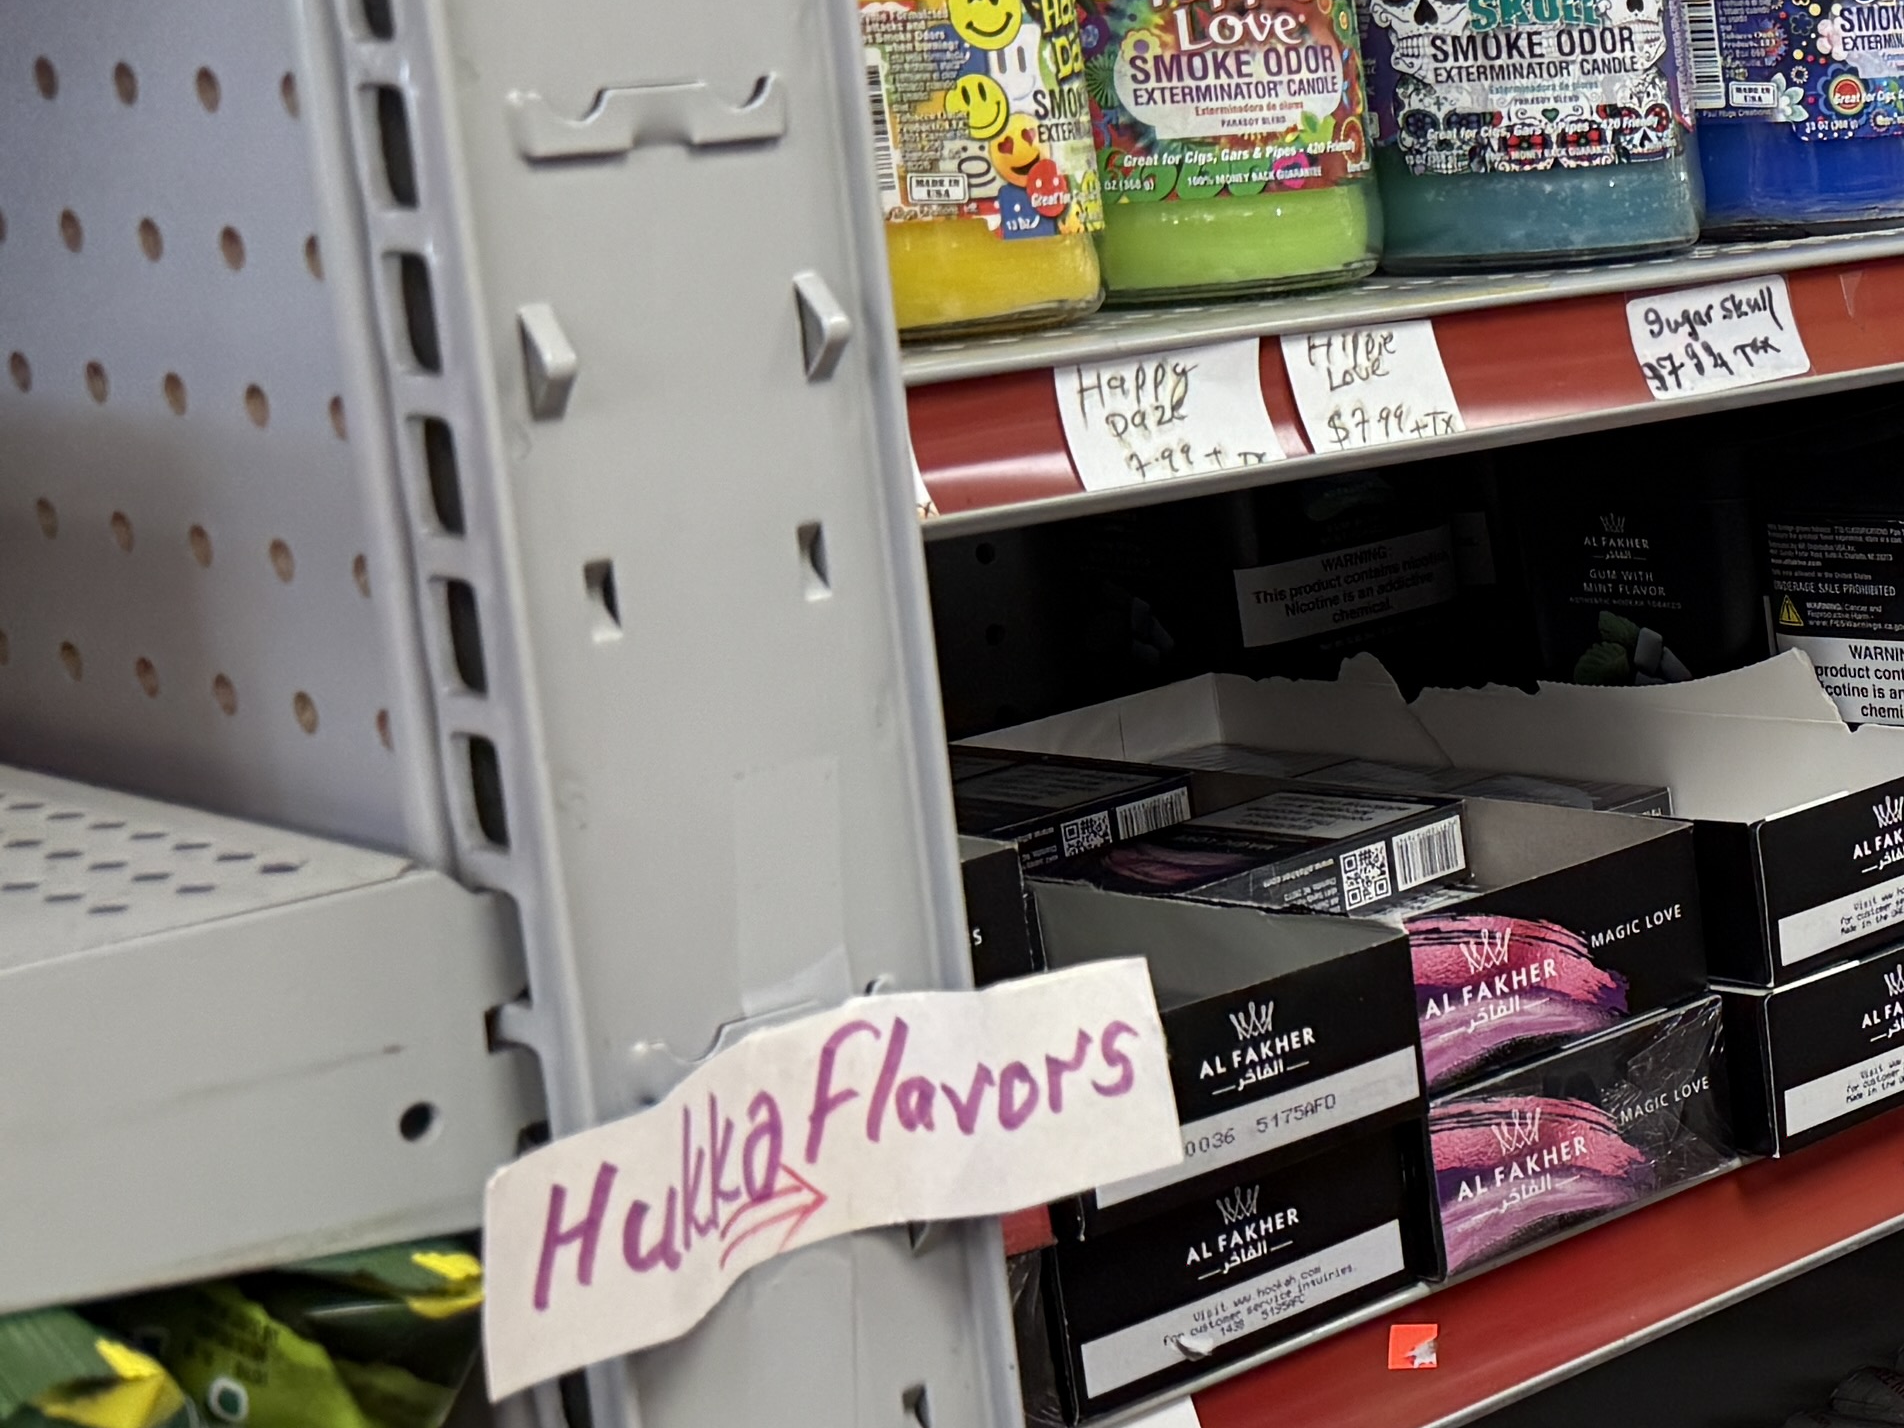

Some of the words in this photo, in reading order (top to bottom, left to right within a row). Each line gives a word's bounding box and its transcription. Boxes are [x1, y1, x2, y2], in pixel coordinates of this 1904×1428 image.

[1172, 8, 1301, 50] Love
[1430, 34, 1546, 64] SMOKE
[1557, 27, 1636, 56] ODOR
[1129, 53, 1236, 87] SMOKE
[1244, 45, 1335, 78] ODOR
[1433, 63, 1575, 85] EXTERMINATOR
[1579, 56, 1639, 76] CANDLE
[1133, 81, 1282, 107] EXTERMINATOR
[1285, 74, 1338, 97] CANDLE
[1124, 152, 1162, 168] Great
[1163, 150, 1183, 167] for
[1184, 149, 1217, 168] Cigs,
[1221, 149, 1253, 164] Gars
[1265, 146, 1297, 164] Pipes
[1074, 362, 1199, 413] Happy
[1325, 355, 1389, 388] Love
[1326, 405, 1404, 448] $7.99
[1128, 446, 1196, 475] 7.99
[1815, 665, 1870, 680] product
[1873, 684, 1885, 699] is
[1853, 841, 1870, 860] AL
[1590, 927, 1641, 950] MAGIC
[1644, 903, 1683, 934] LOVE
[1425, 993, 1457, 1020] AL
[1462, 957, 1559, 1007] FAKHER
[1200, 1057, 1228, 1079] AL
[1232, 1026, 1316, 1068] FAKHER
[1619, 1100, 1669, 1124] MAGIC
[1672, 1076, 1711, 1103] LOVE
[531, 1091, 787, 1311] Hukka
[805, 1018, 1139, 1165] Flavors
[1457, 1179, 1486, 1203] AL
[1491, 1137, 1588, 1191] FAKHER
